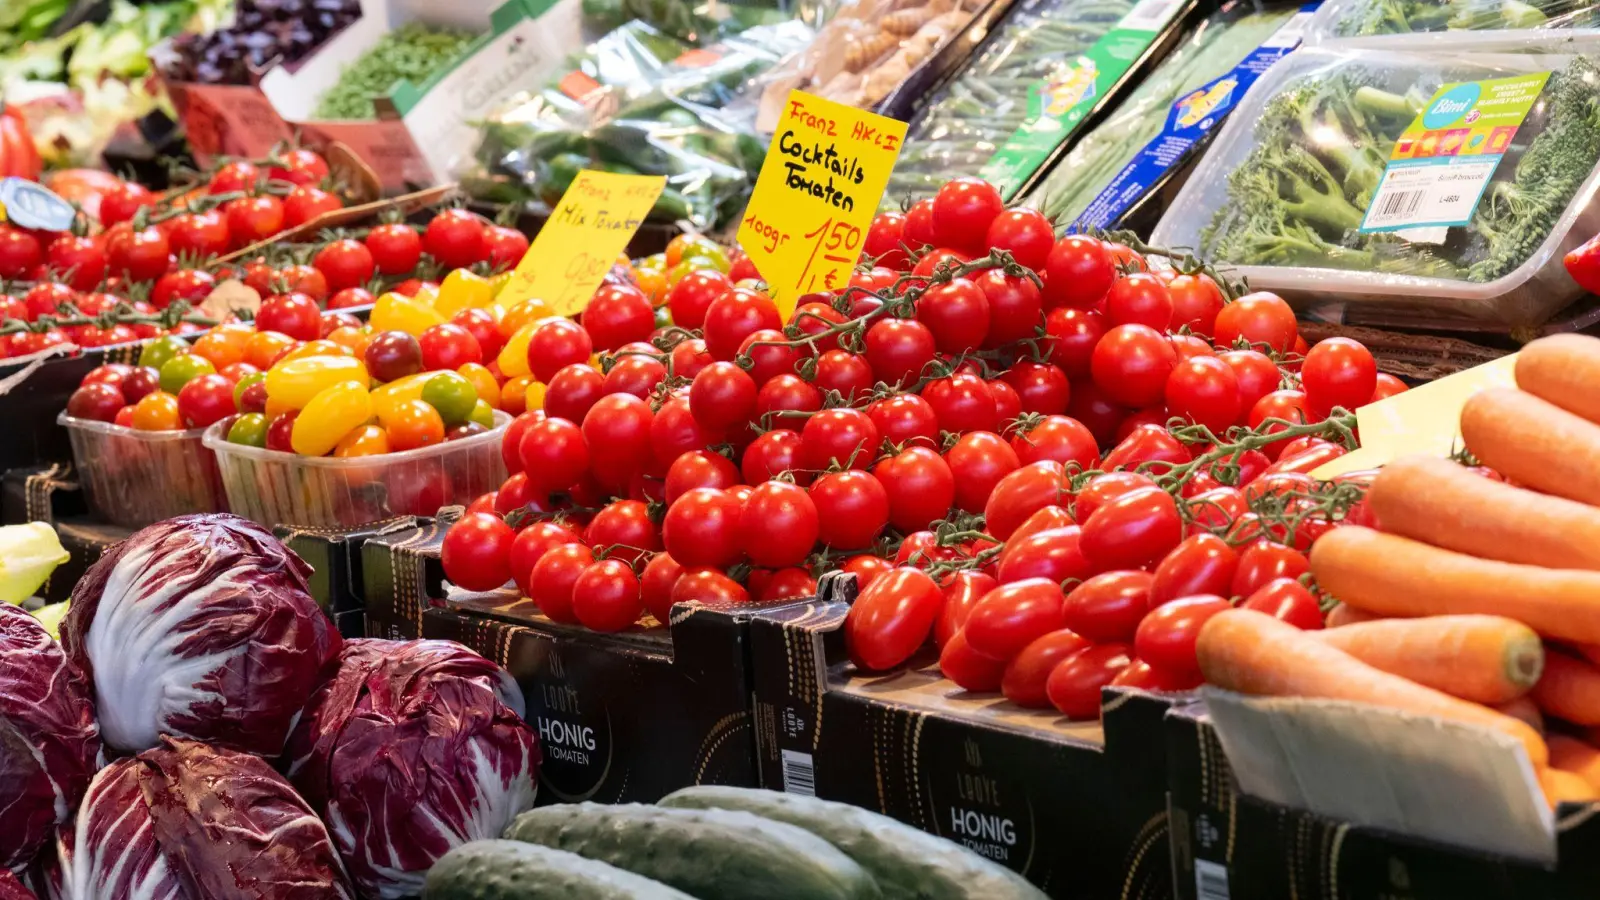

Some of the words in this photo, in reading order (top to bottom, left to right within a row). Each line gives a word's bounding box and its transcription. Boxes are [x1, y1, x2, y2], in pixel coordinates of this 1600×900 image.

[791, 101, 837, 136] Franz
[1431, 98, 1472, 115] Bimi
[780, 130, 864, 184] Cocktails
[785, 161, 854, 212] Tomaten
[556, 203, 586, 226] Mix
[538, 716, 596, 751] HONIG
[548, 745, 590, 766] TOMATEN
[951, 806, 1017, 845] HONIG
